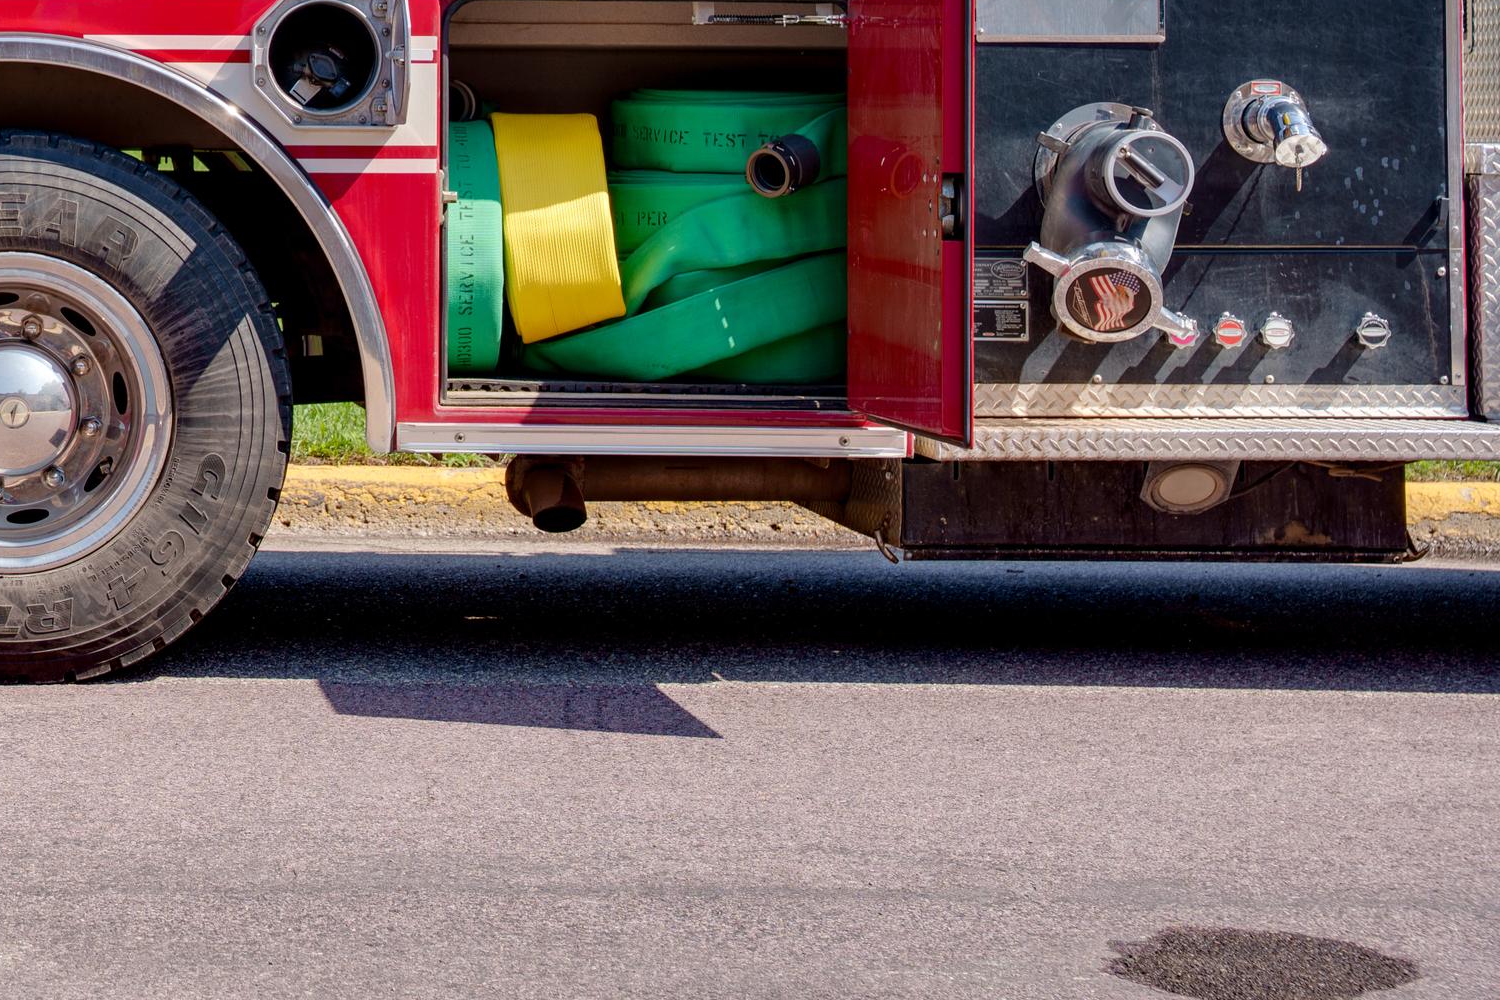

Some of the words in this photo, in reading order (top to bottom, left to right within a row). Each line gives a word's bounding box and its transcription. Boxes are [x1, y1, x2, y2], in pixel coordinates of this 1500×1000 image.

[632, 126, 690, 146] SERVICE
[702, 132, 748, 148] TEST
[459, 181, 474, 221] TEST
[637, 211, 668, 226] PER
[459, 234, 475, 317] SERVICE
